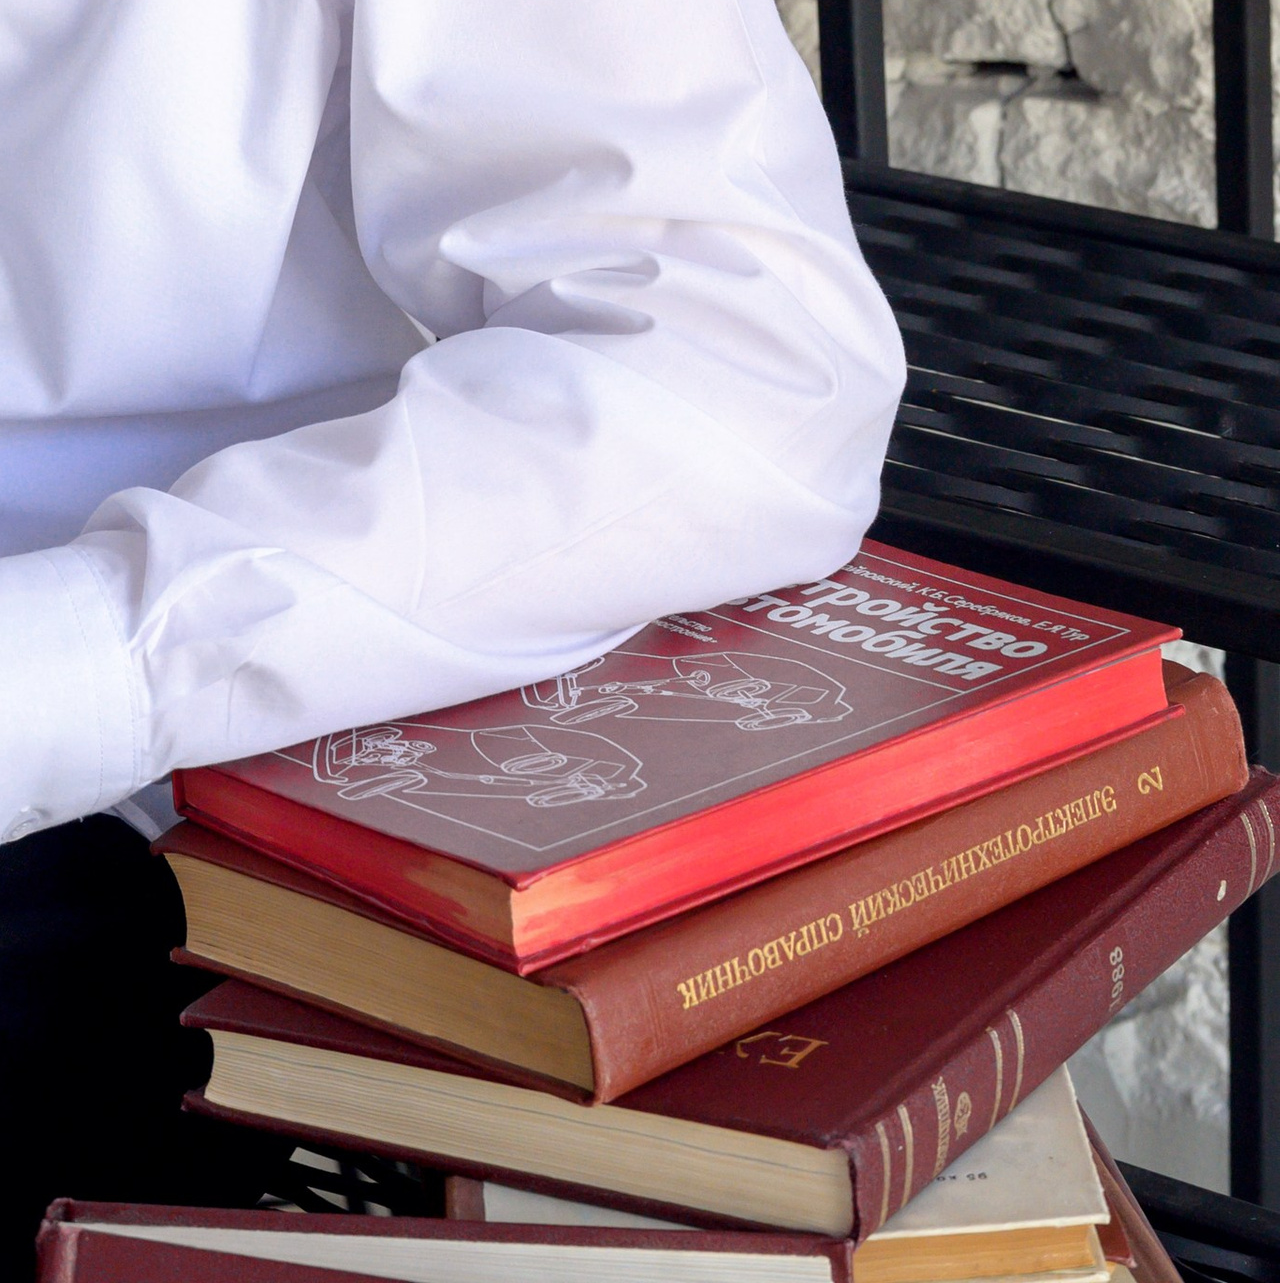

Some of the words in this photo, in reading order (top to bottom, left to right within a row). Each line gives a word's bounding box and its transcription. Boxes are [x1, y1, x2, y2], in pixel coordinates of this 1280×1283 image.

[850, 785, 1117, 938] ЭЛЕКТРОТЕХНИЧЕСКИЙ
[677, 912, 842, 1009] СПРАВОЧНИК
[1109, 946, 1125, 1012] 1988
